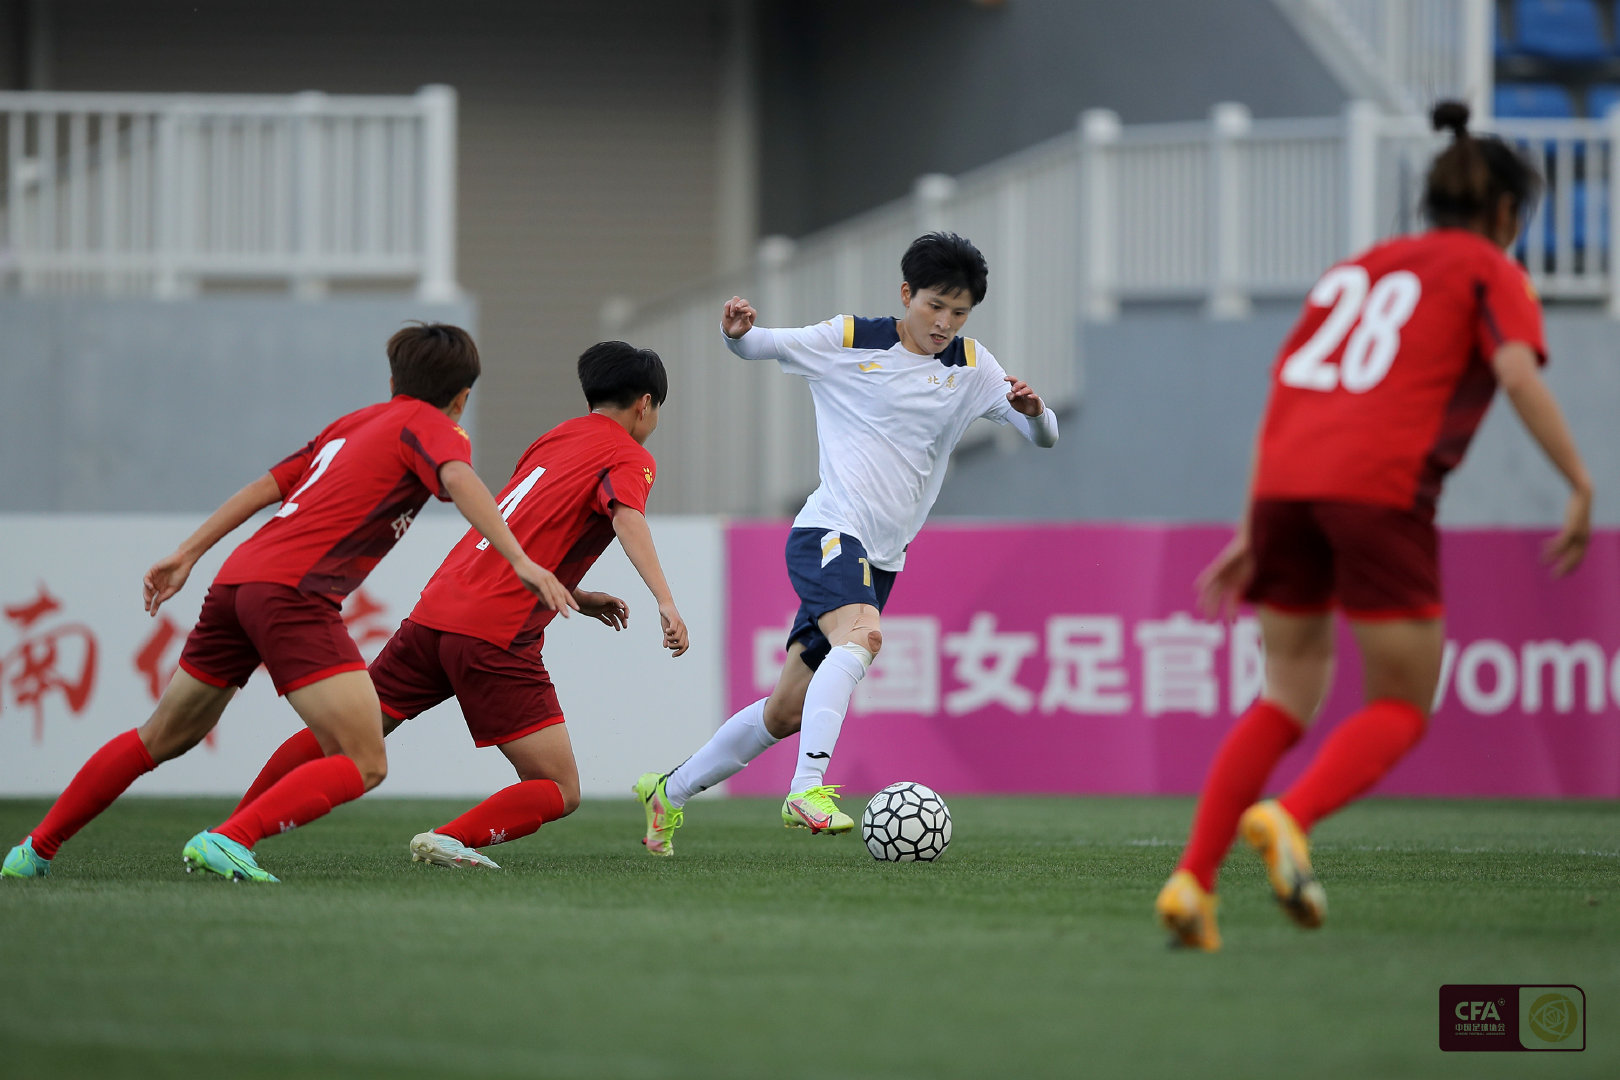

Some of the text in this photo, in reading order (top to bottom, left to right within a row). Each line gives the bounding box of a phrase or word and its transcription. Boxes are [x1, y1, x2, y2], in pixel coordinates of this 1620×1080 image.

[1280, 264, 1422, 393] 28
[274, 438, 347, 519] 2
[475, 465, 548, 552] 4
